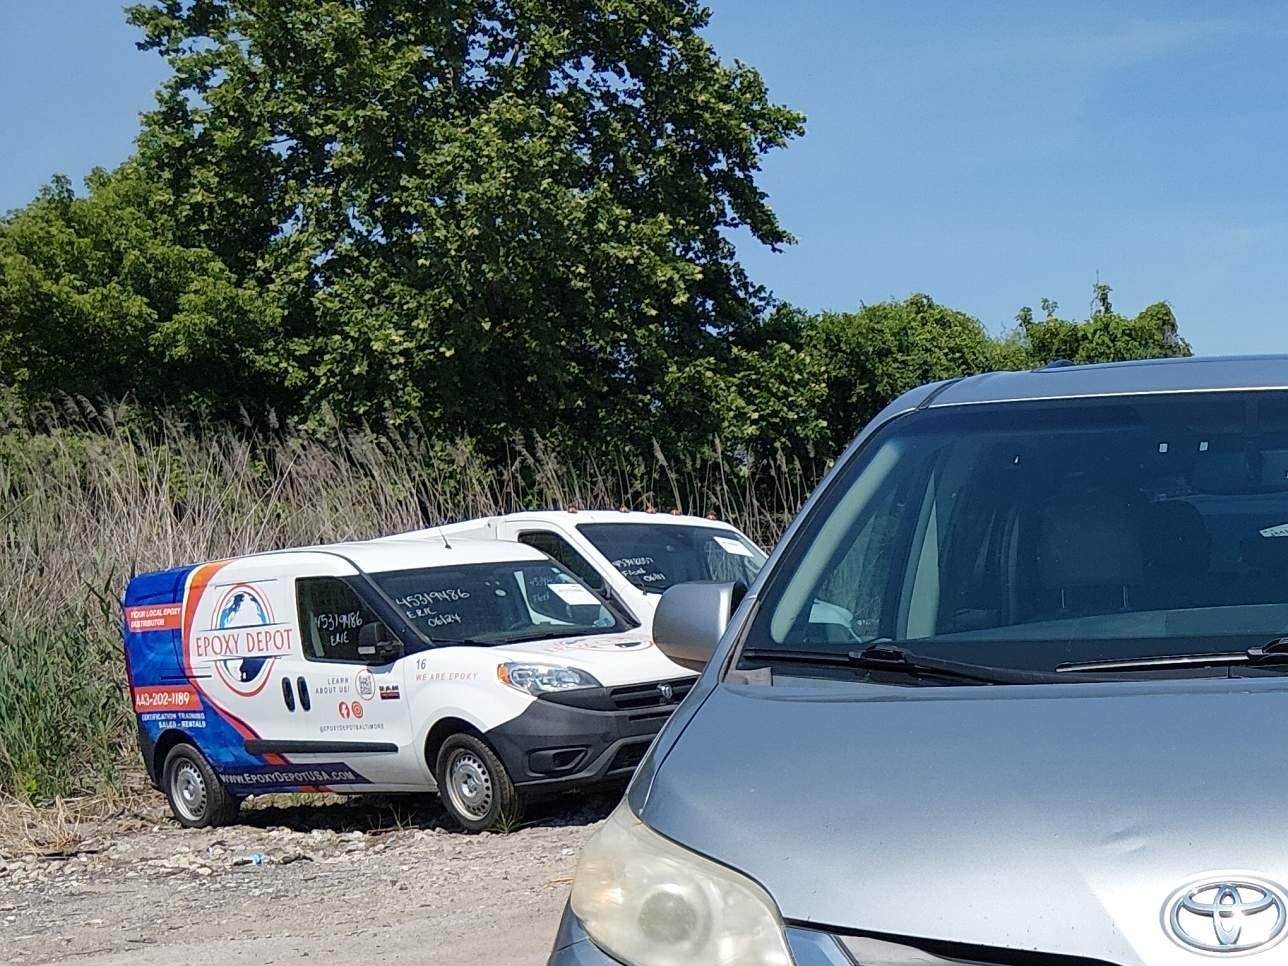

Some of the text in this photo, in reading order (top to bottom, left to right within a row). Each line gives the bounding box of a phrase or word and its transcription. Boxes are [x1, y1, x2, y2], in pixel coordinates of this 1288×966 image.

[396, 588, 471, 607] 45319486
[145, 608, 163, 618] LOCAL
[195, 628, 293, 657] EPOXY DEPOT
[415, 658, 427, 671] 16
[327, 676, 349, 685] LEARN
[449, 672, 479, 680] EPOXY
[315, 687, 337, 695] ABOUT
[135, 691, 190, 706] 443-202-1189
